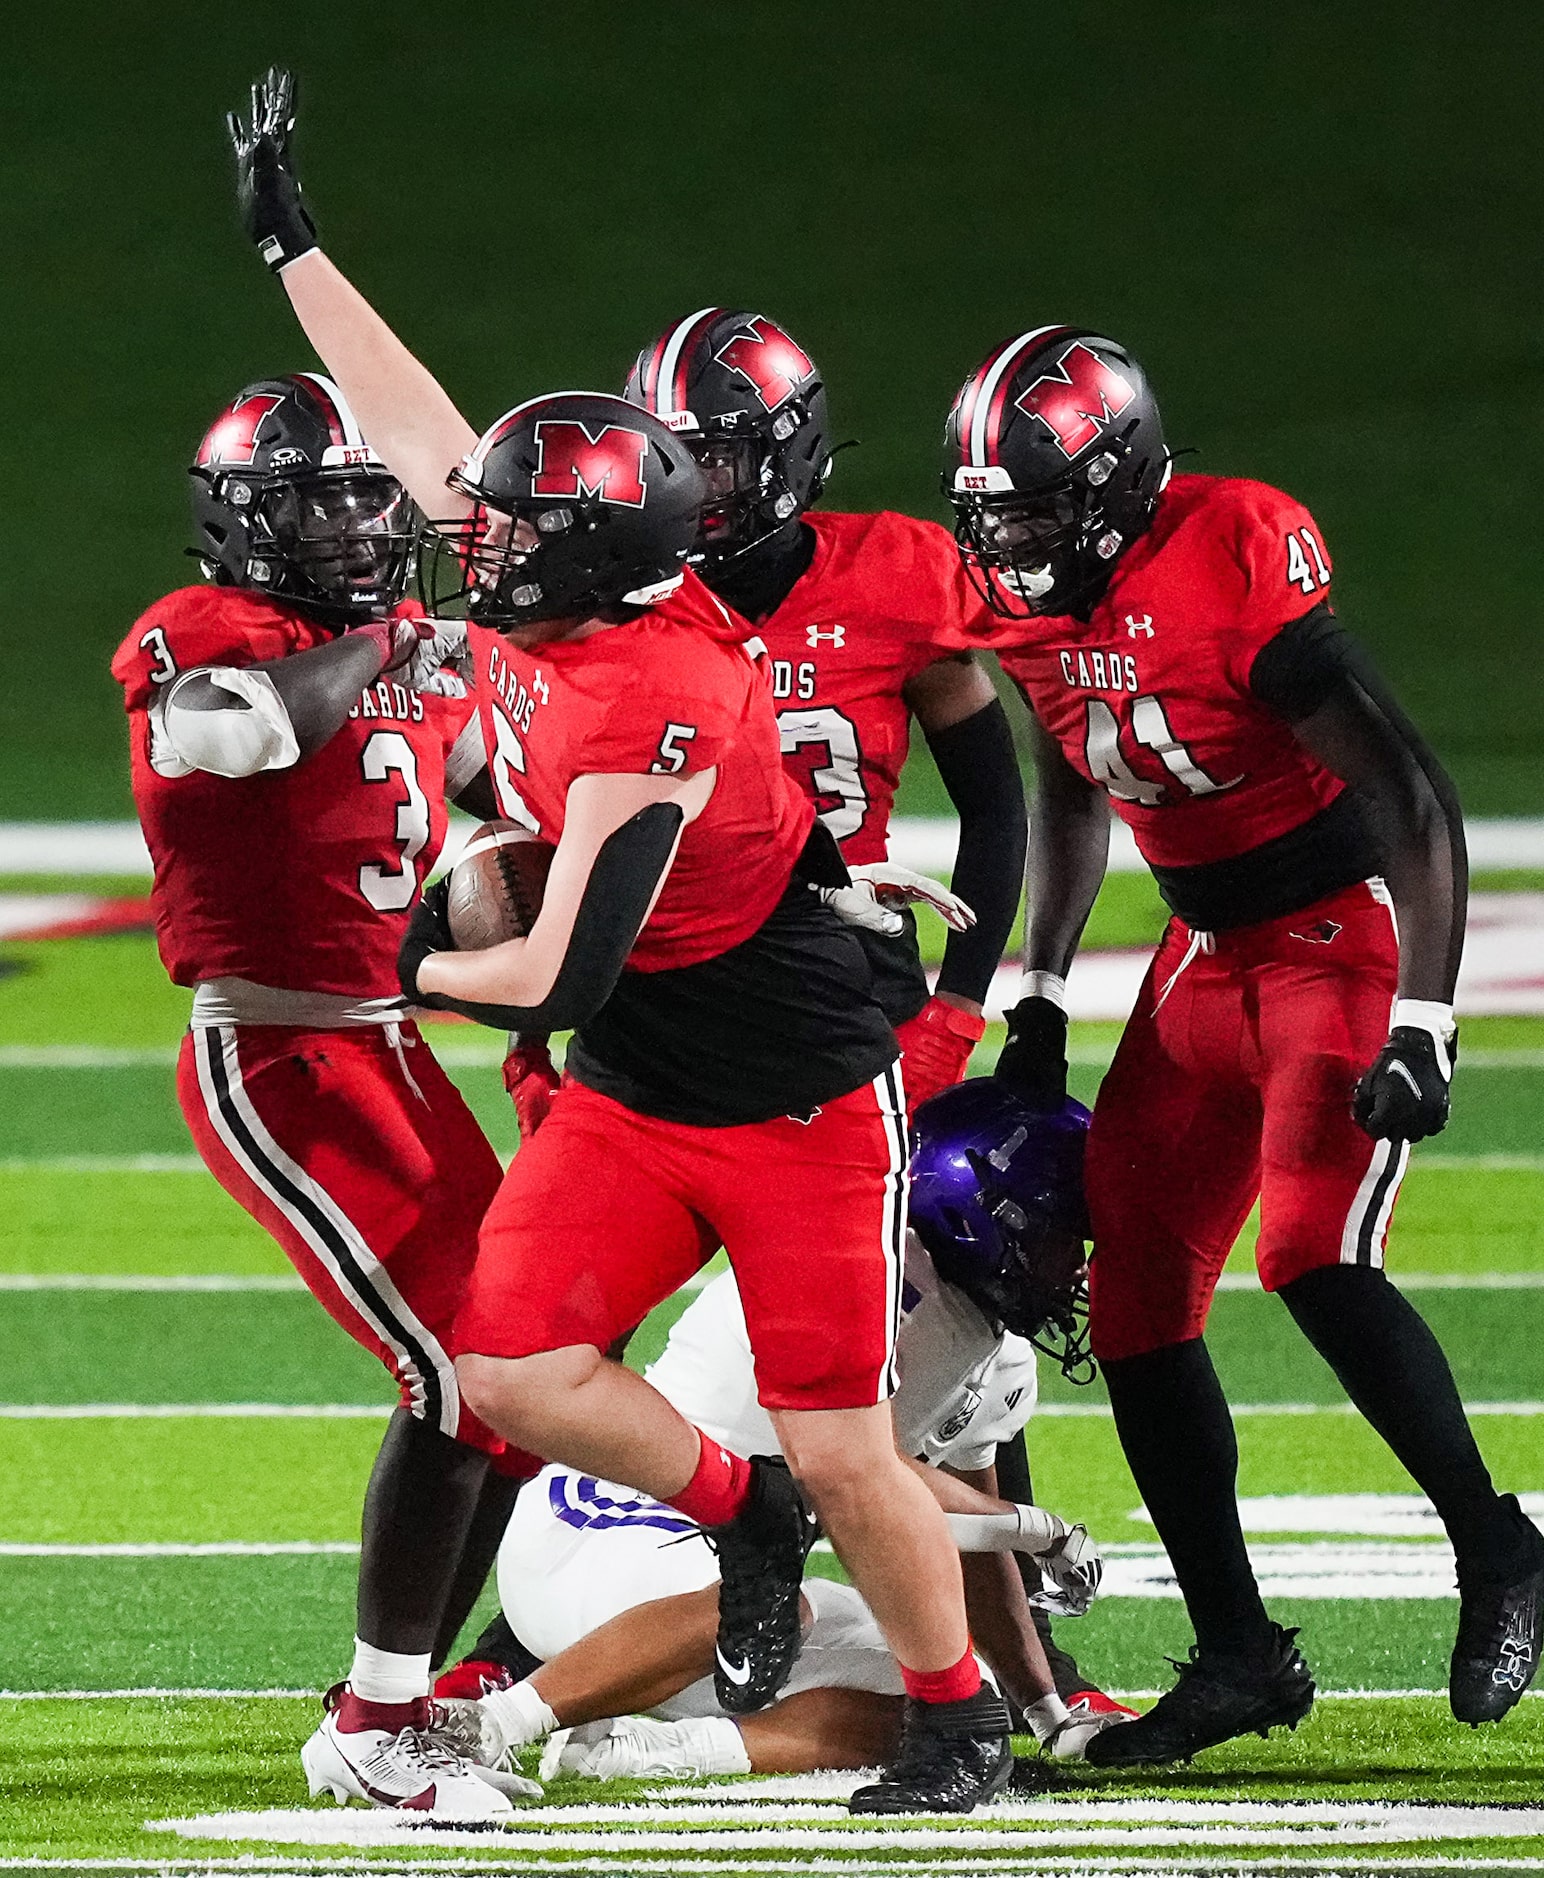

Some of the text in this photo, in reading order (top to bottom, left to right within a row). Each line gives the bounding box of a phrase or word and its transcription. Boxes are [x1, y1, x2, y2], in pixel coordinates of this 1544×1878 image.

[713, 314, 816, 414] M
[1013, 340, 1137, 462] M
[530, 419, 649, 510] M
[1286, 525, 1331, 594] 41
[139, 625, 178, 684] 3
[487, 646, 535, 735] CARDS
[1058, 650, 1139, 693] CARDS
[651, 722, 697, 774] 5
[1086, 695, 1246, 805] 41
[359, 729, 430, 913] 3
